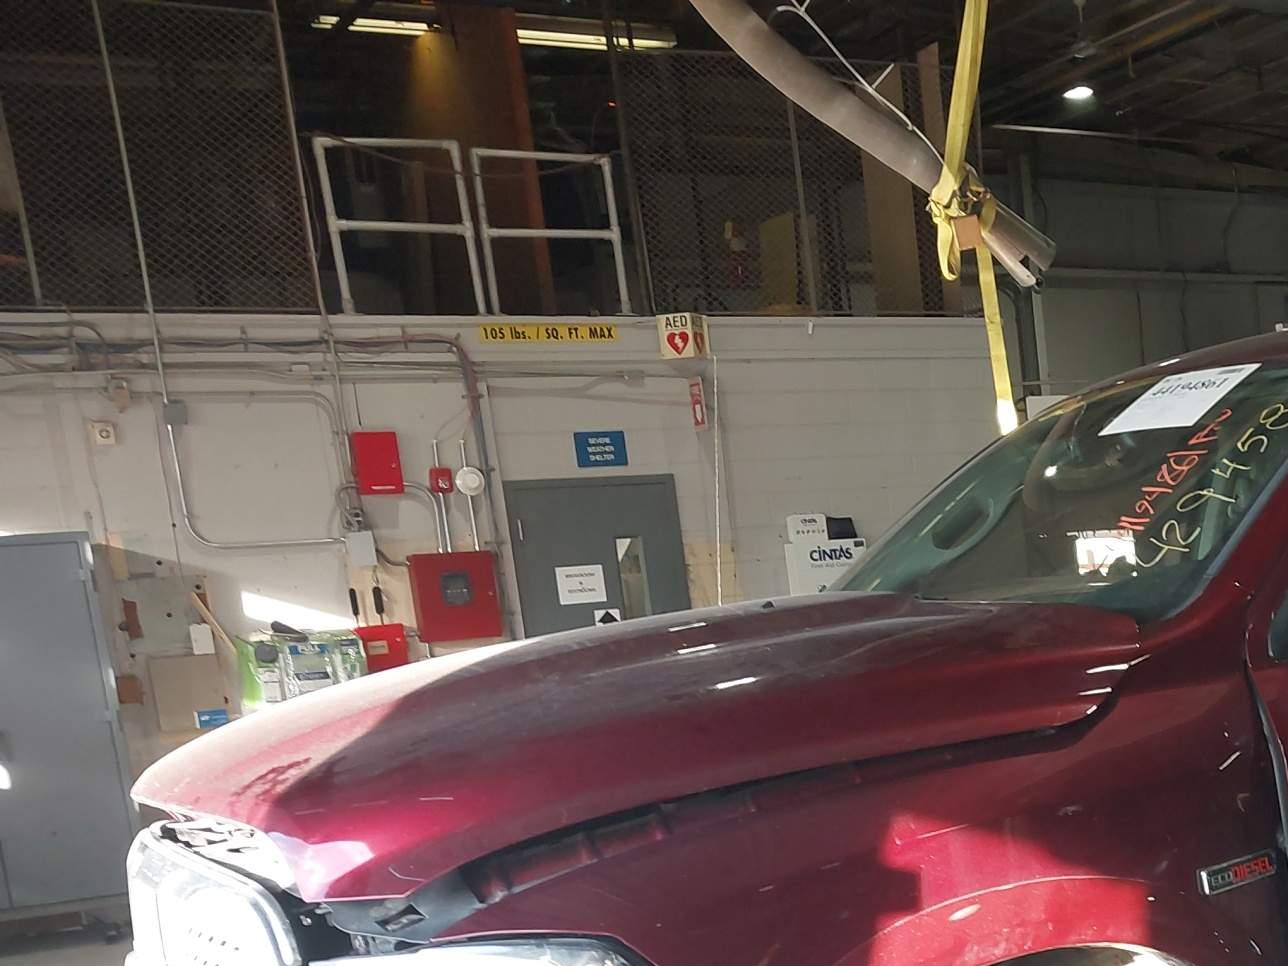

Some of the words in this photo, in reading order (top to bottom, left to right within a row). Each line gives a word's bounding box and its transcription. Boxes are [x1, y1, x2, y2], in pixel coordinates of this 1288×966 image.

[665, 315, 688, 329] AED
[483, 327, 506, 340] 105
[509, 326, 532, 340] lbs.
[545, 327, 564, 341] SQ.
[567, 327, 584, 340] FT.
[588, 326, 614, 340] MAX
